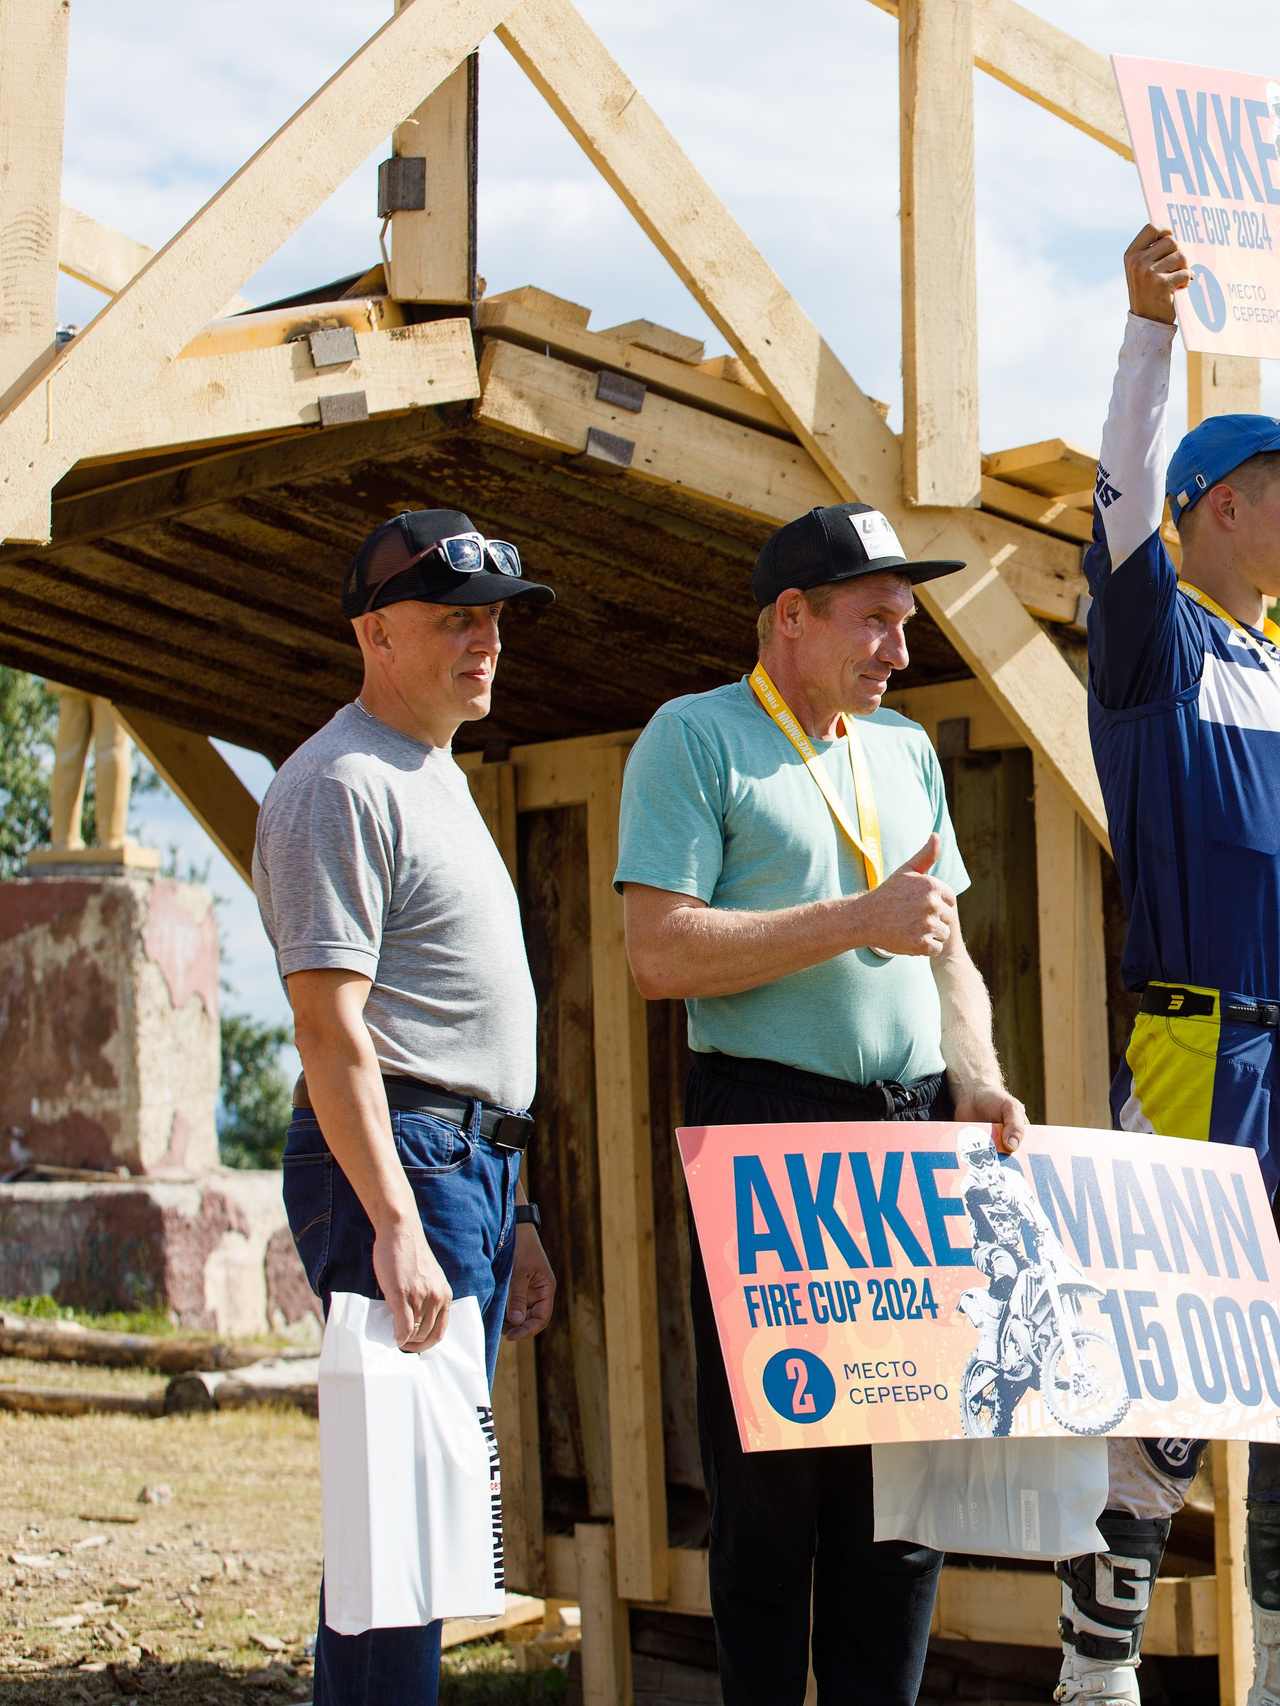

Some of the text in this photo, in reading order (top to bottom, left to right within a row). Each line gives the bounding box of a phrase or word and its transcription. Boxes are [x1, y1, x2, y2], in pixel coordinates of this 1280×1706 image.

[1167, 203, 1273, 251] FIRE CUP 2024
[1197, 275, 1216, 324] 1
[1227, 282, 1267, 302] МЕСТО
[755, 675, 769, 692] CUP
[764, 690, 780, 709] FIRE
[733, 1151, 1270, 1283] AKKEMANN
[743, 1278, 939, 1328] FIRE CUP 2024
[785, 1357, 817, 1415] 2
[843, 1360, 918, 1380] МЕСТО
[849, 1384, 949, 1405] СЕРЕБРО
